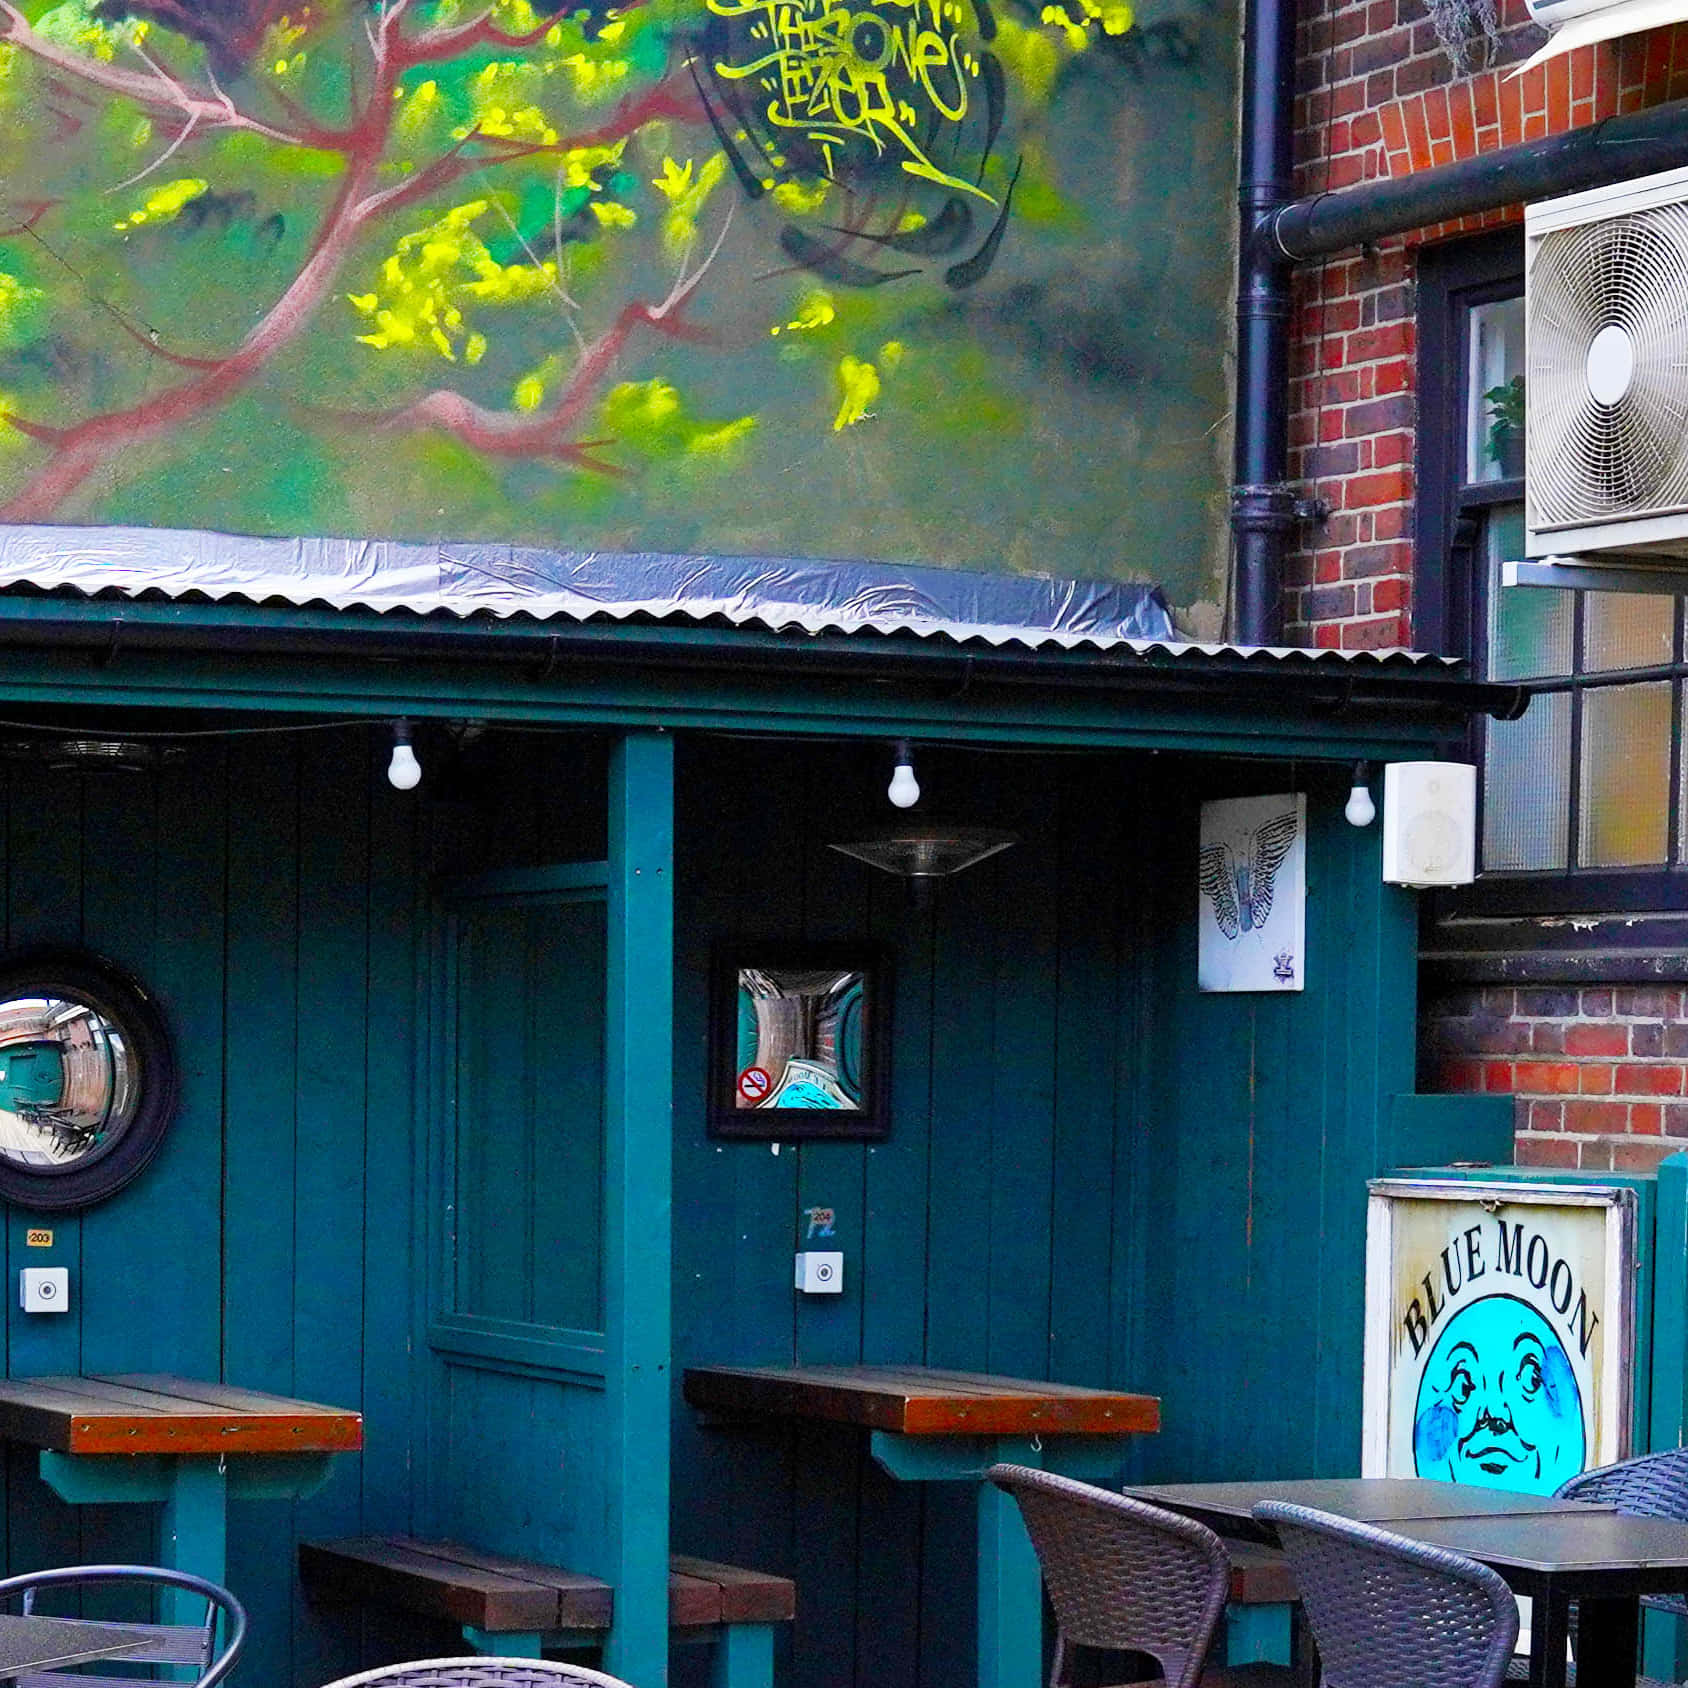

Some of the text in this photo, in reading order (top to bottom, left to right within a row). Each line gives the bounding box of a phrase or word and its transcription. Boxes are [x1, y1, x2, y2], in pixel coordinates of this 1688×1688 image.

[30, 1232, 50, 1243] 203
[1403, 1220, 1600, 1360] BLUE MOON
